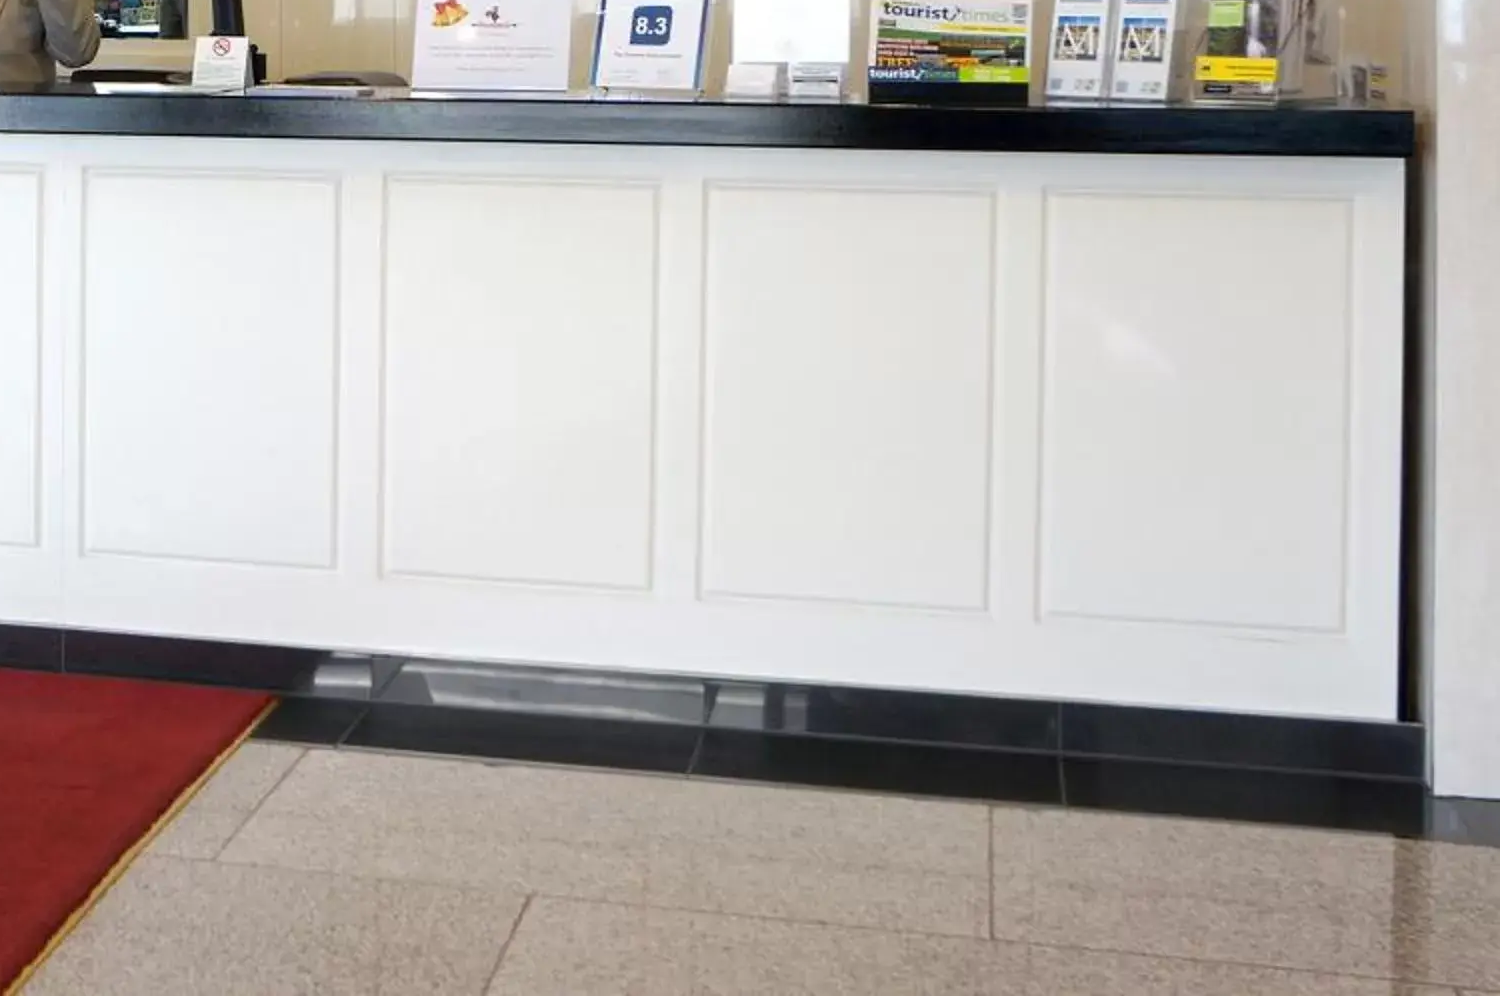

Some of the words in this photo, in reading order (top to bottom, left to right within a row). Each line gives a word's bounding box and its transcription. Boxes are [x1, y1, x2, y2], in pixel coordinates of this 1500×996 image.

[883, 1, 952, 20] tourist
[635, 16, 667, 35] 8.3
[869, 68, 918, 80] tourist
